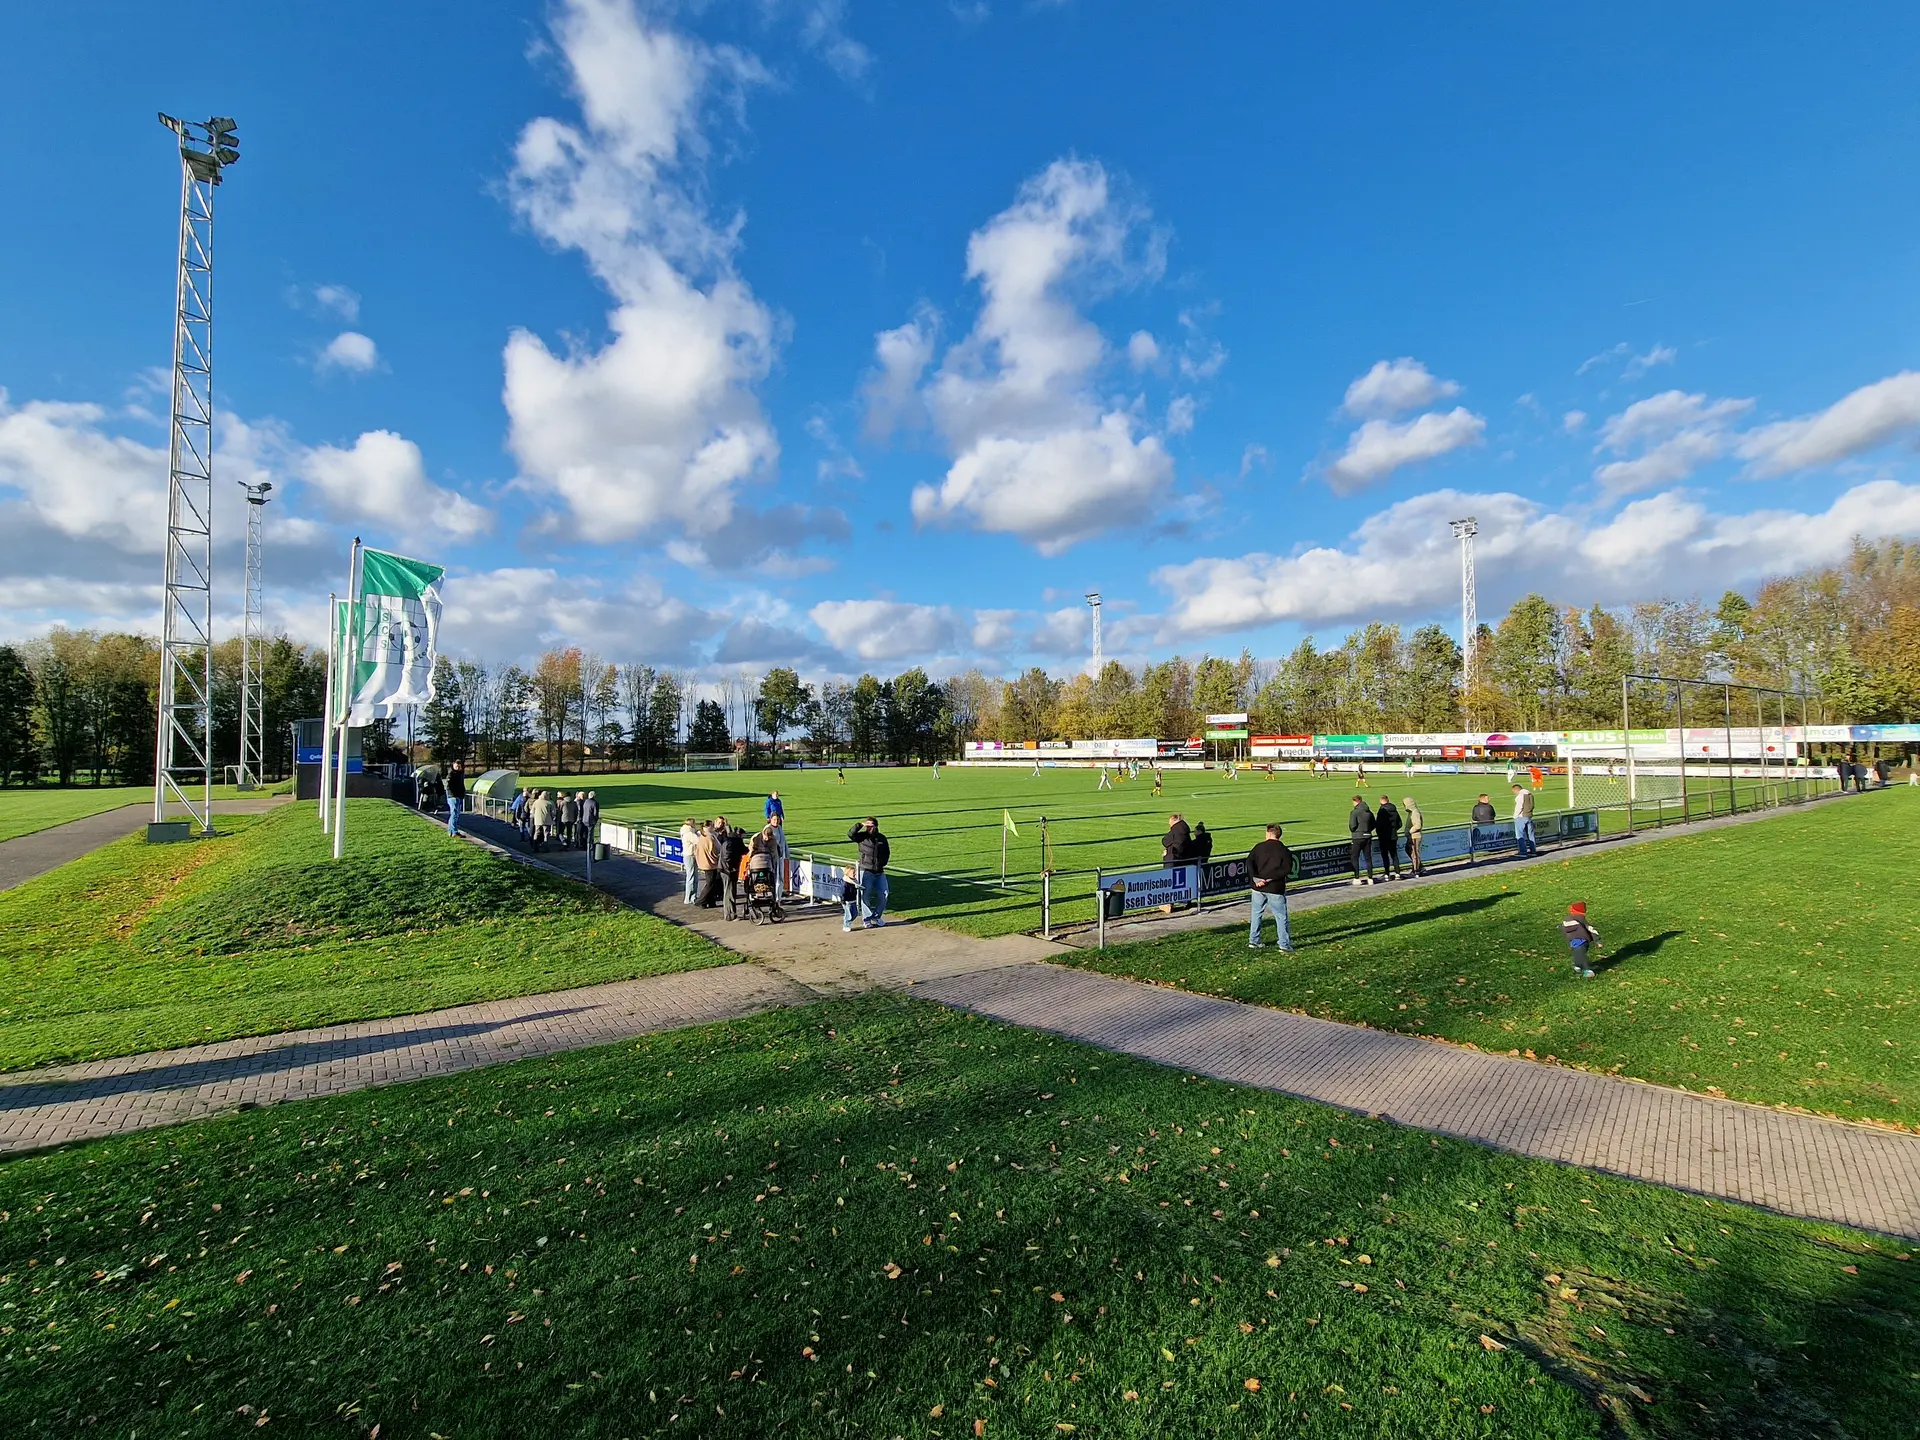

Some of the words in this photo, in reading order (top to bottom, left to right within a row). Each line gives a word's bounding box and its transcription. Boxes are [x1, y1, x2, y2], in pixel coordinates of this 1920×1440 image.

[1572, 732, 1617, 742] PLUS
[1619, 732, 1665, 741] Combach
[1284, 747, 1311, 755] media
[1300, 849, 1326, 862] FREEK'S
[1327, 846, 1350, 857] GARAG
[1126, 896, 1146, 909] ssen
[1147, 887, 1192, 906] Susteren.nl
